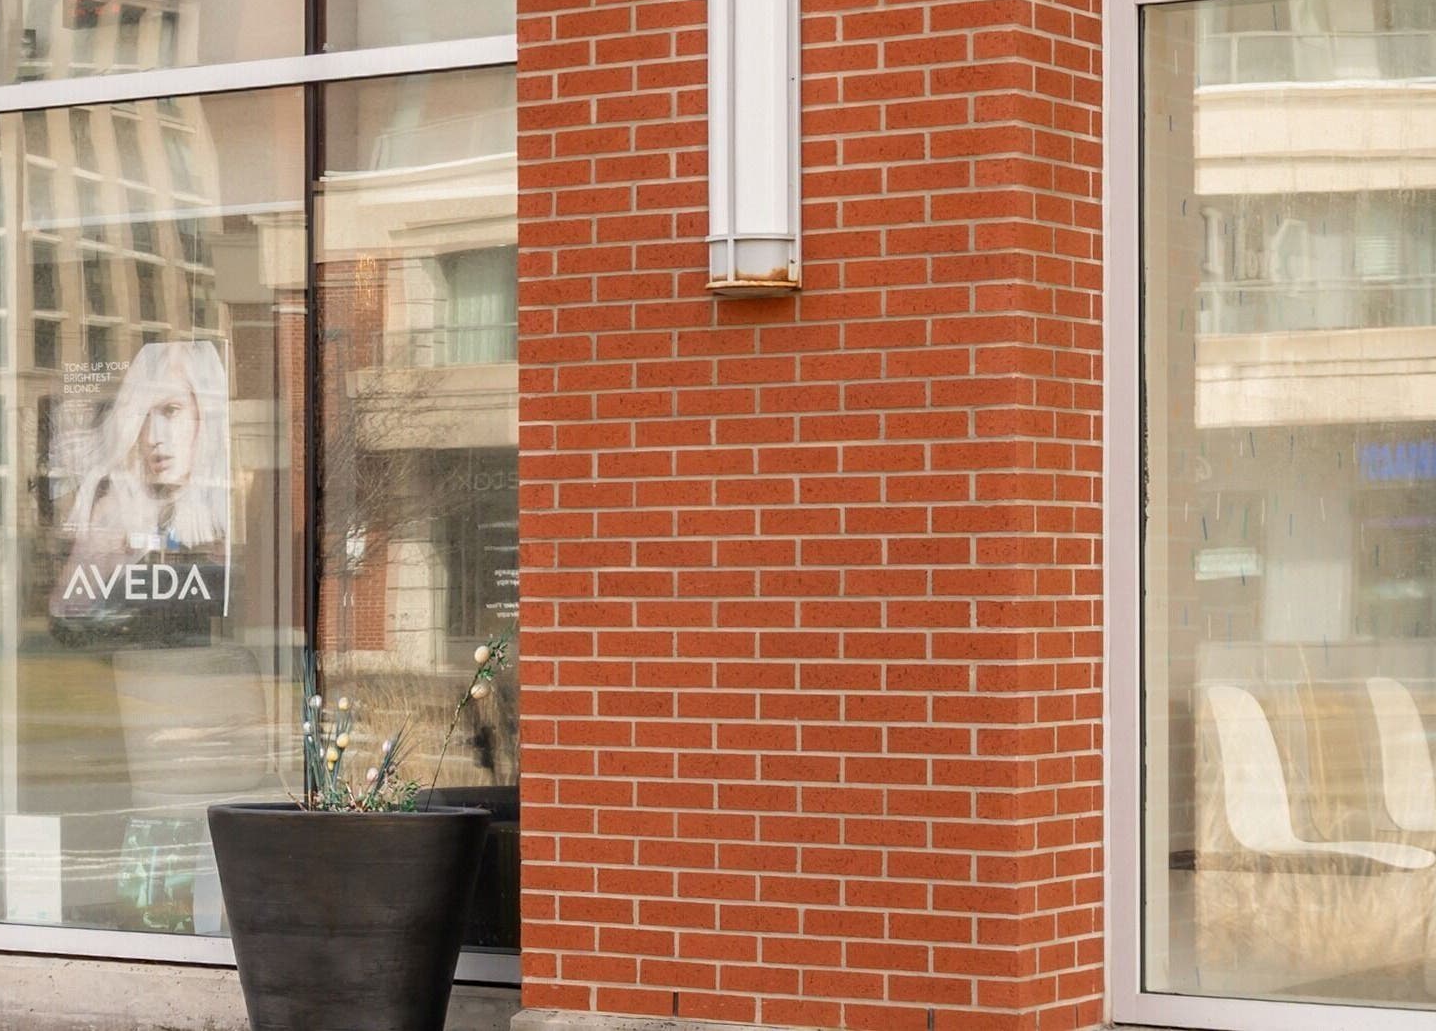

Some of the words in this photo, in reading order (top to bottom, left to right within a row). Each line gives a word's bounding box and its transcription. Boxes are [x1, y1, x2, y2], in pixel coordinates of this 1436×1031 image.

[64, 363, 89, 372] TONE
[90, 362, 104, 371] UP
[104, 361, 130, 371] YOUR
[64, 372, 111, 383] BRIGHTEST
[64, 383, 101, 394] BLONDE
[63, 564, 212, 600] AVEDA
